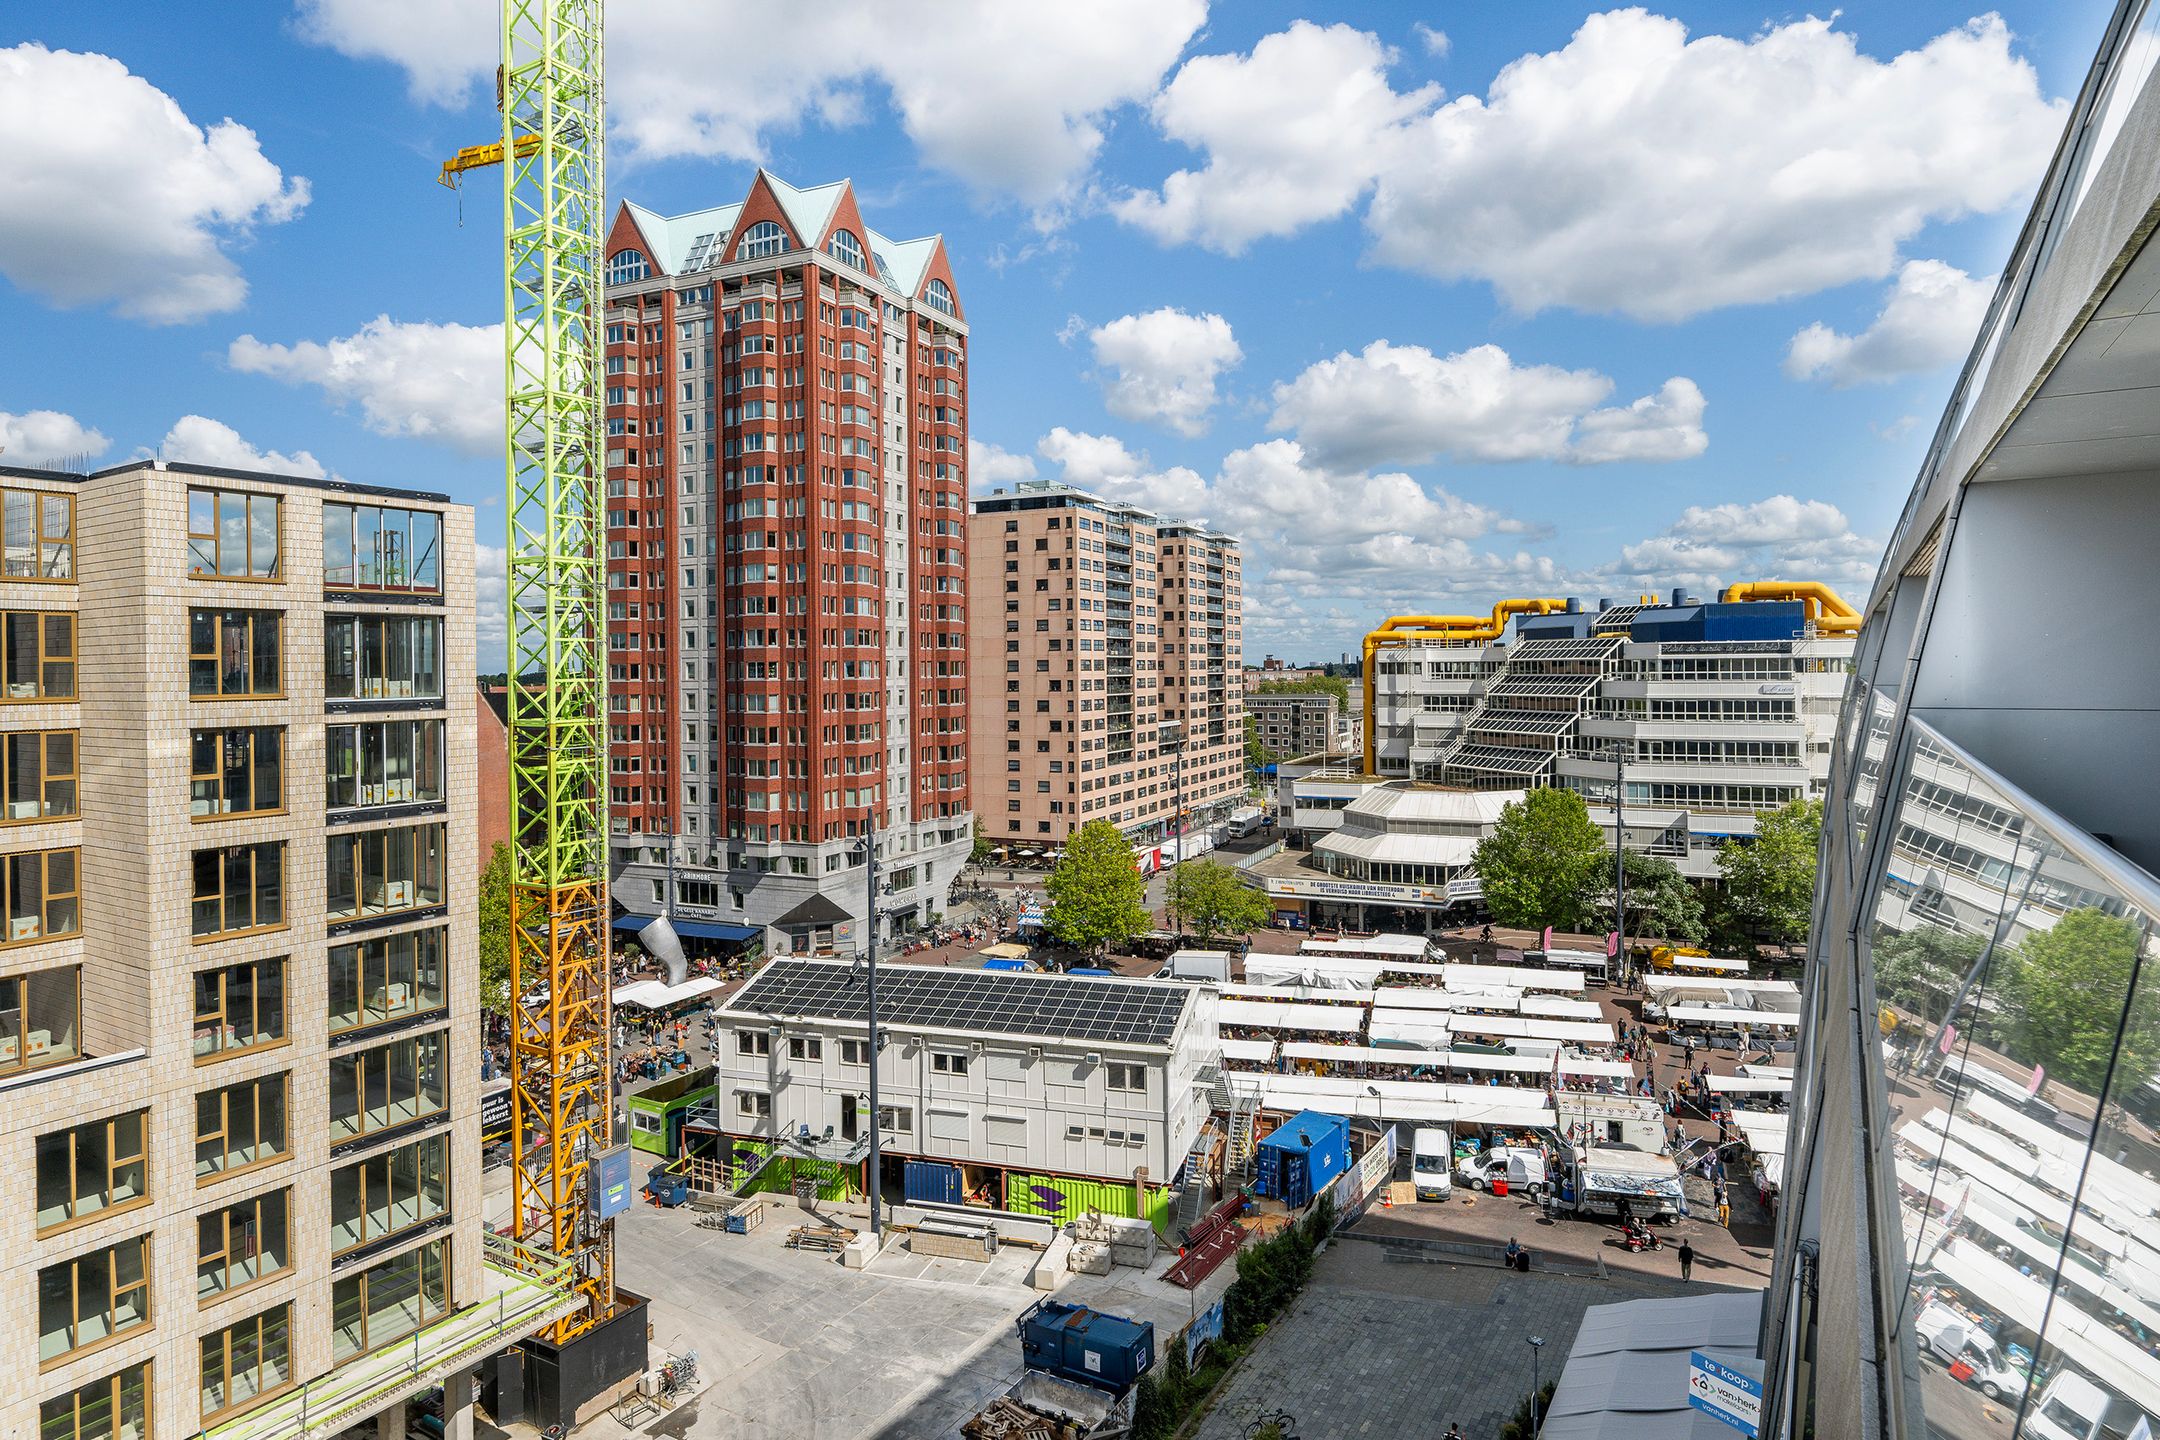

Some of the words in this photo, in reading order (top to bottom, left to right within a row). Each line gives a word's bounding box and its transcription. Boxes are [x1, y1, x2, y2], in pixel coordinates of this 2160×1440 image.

[1339, 883, 1367, 891] HUISKAMER
[1377, 885, 1405, 893] ROTTERDAM
[482, 1099, 498, 1111] puur
[497, 1096, 504, 1104] is
[482, 1103, 508, 1118] gewoon
[482, 1109, 509, 1125] lekkerst
[1704, 1359, 1716, 1372] te
[1721, 1367, 1749, 1389] koop
[1702, 1403, 1739, 1426] vanherk.nl
